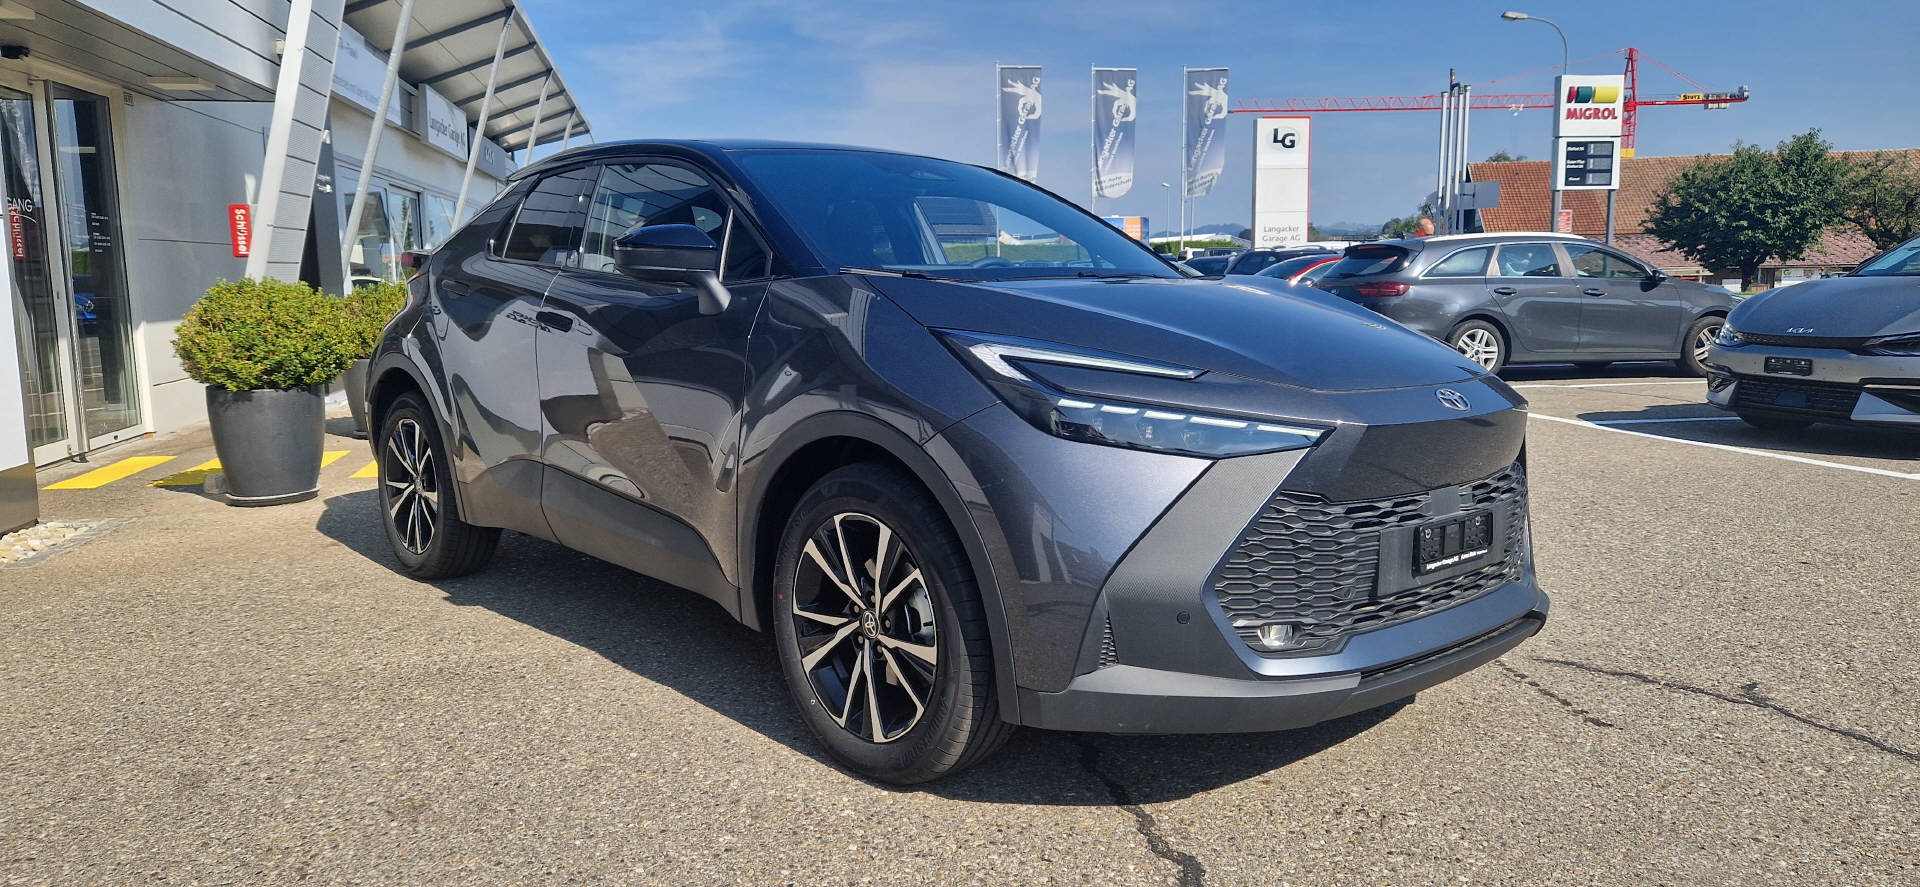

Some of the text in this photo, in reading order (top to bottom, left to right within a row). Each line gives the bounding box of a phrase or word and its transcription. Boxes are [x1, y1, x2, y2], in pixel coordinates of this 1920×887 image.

[1566, 107, 1618, 120] MIGROL
[1272, 127, 1296, 149] LG
[1263, 225, 1300, 234] Langacker
[1262, 234, 1288, 243] Garage
